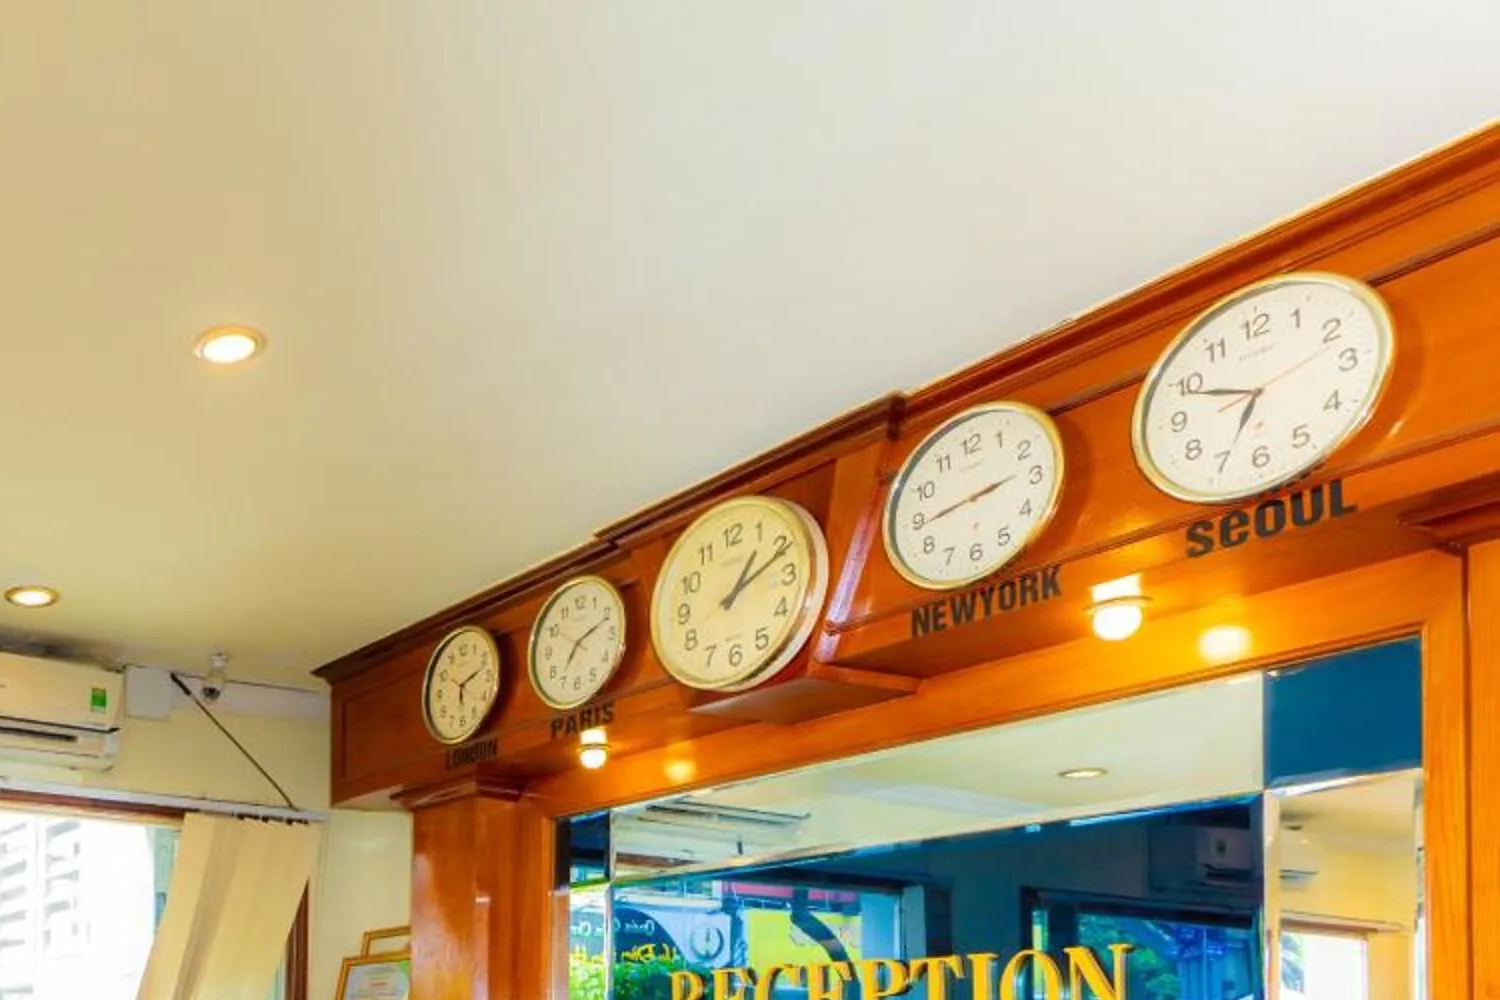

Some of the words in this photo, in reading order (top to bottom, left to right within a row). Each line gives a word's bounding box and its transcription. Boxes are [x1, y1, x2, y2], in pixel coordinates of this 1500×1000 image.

[1241, 314, 1270, 339] 12
[1290, 307, 1301, 328] 1
[1322, 318, 1342, 344] 2
[1205, 338, 1226, 362] 11
[1338, 348, 1358, 371] 3
[1176, 373, 1203, 395] 10
[1323, 391, 1342, 412] 4
[1171, 411, 1187, 432] 9
[961, 433, 982, 455] 12
[996, 430, 1004, 448] 1
[1291, 426, 1310, 449] 5
[1017, 439, 1032, 461] 2
[1185, 440, 1202, 460] 8
[1252, 447, 1270, 467] 6
[936, 455, 952, 473] 11
[1215, 451, 1230, 474] 7
[1029, 465, 1043, 485] 3
[916, 481, 935, 501] 10
[1019, 499, 1033, 517] 4
[754, 521, 763, 542] 1
[912, 513, 925, 531] 9
[723, 522, 743, 549] 12
[773, 535, 788, 558] 2
[923, 536, 935, 554] 8
[997, 526, 1011, 546] 5
[699, 543, 713, 566] 11
[943, 547, 956, 566] 7
[969, 543, 983, 561] 6
[681, 571, 701, 595] 10
[781, 563, 797, 586] 3
[773, 596, 789, 617] 4
[911, 563, 1062, 639] NEWYORK
[677, 603, 690, 625] 9
[684, 629, 698, 651] 8
[755, 627, 769, 650] 5
[704, 645, 717, 668] 7
[728, 643, 743, 666] 6
[551, 703, 616, 738] PARIS
